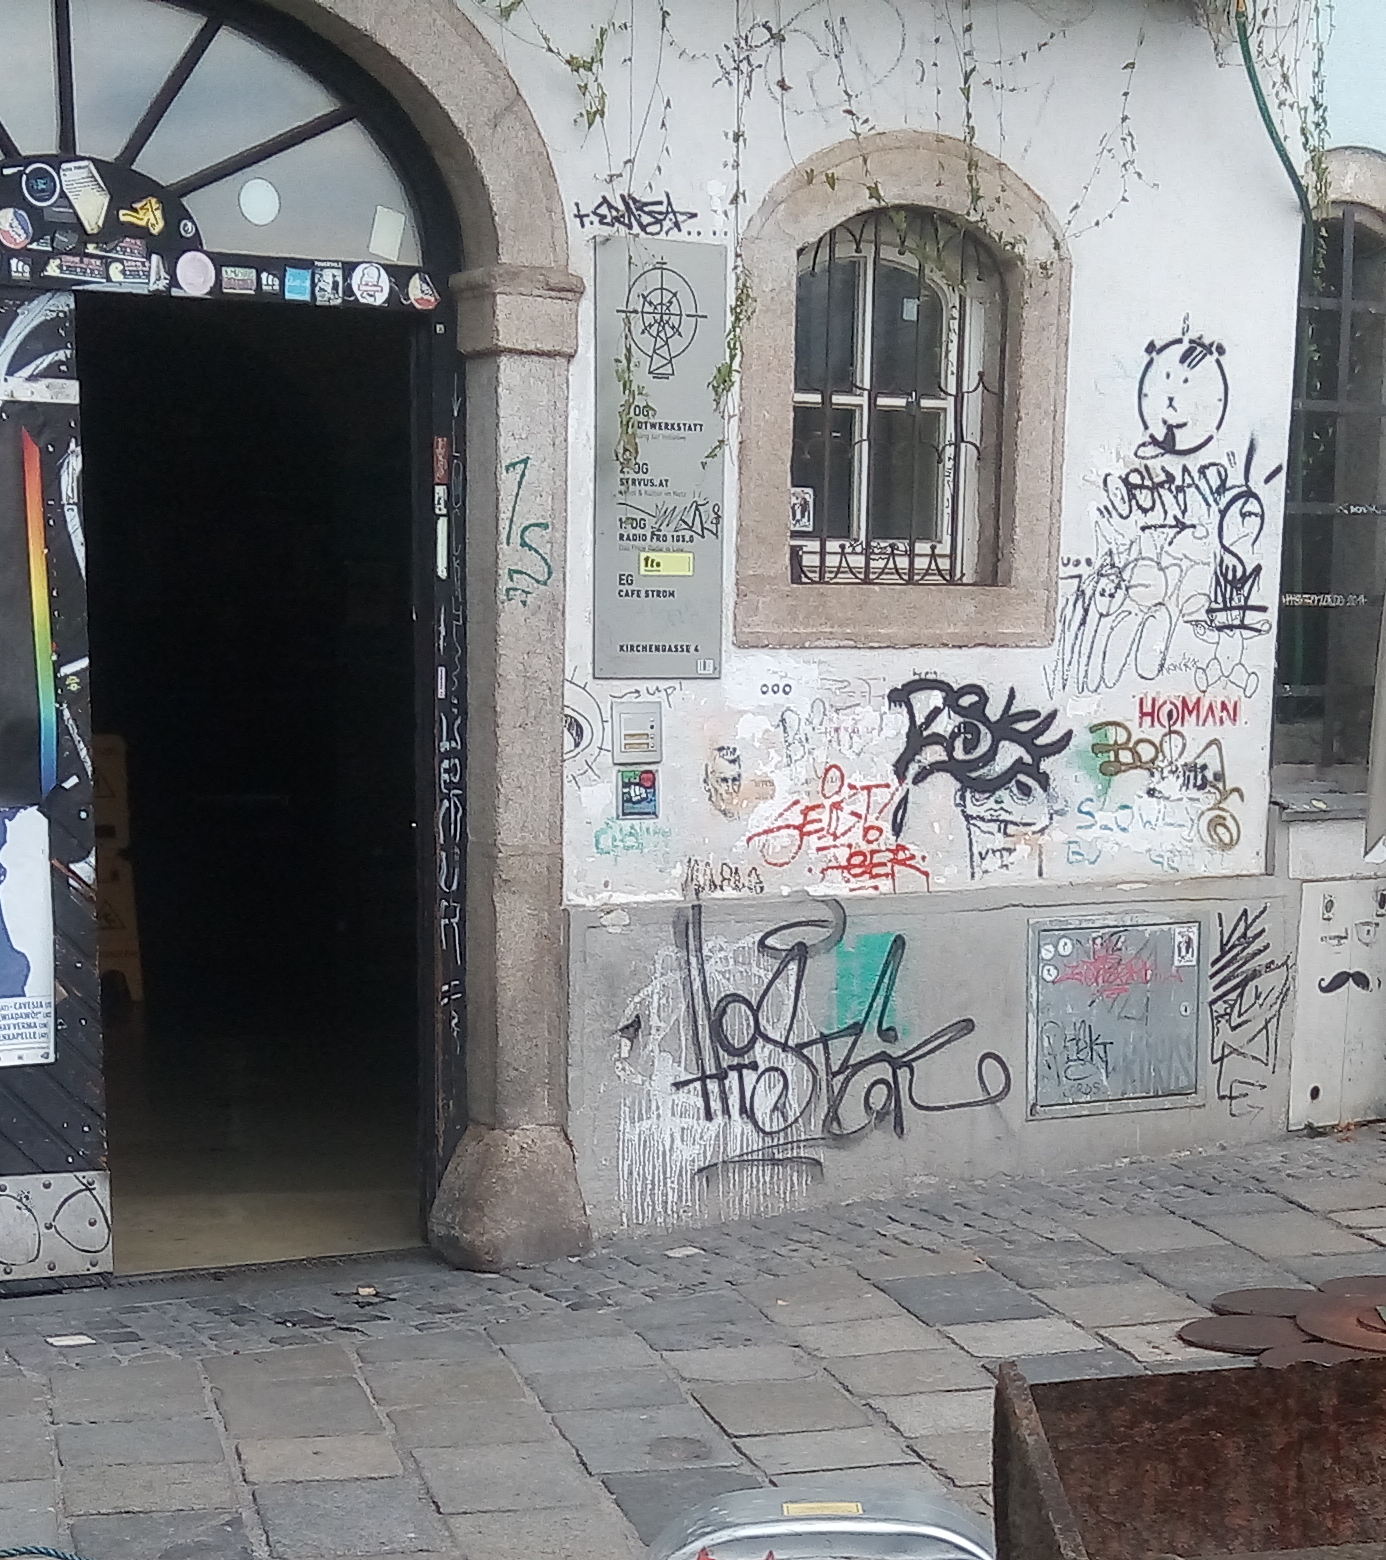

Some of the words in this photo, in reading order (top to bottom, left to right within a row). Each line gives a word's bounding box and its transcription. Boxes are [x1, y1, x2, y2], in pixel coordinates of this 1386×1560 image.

[618, 532, 648, 543] RADIO
[650, 533, 668, 543] FRO
[617, 573, 634, 586] EG
[617, 589, 642, 599] CAFE
[644, 590, 676, 599] STROM
[618, 643, 692, 654] KIRCHENGASSE
[1138, 697, 1242, 728] HOMAN
